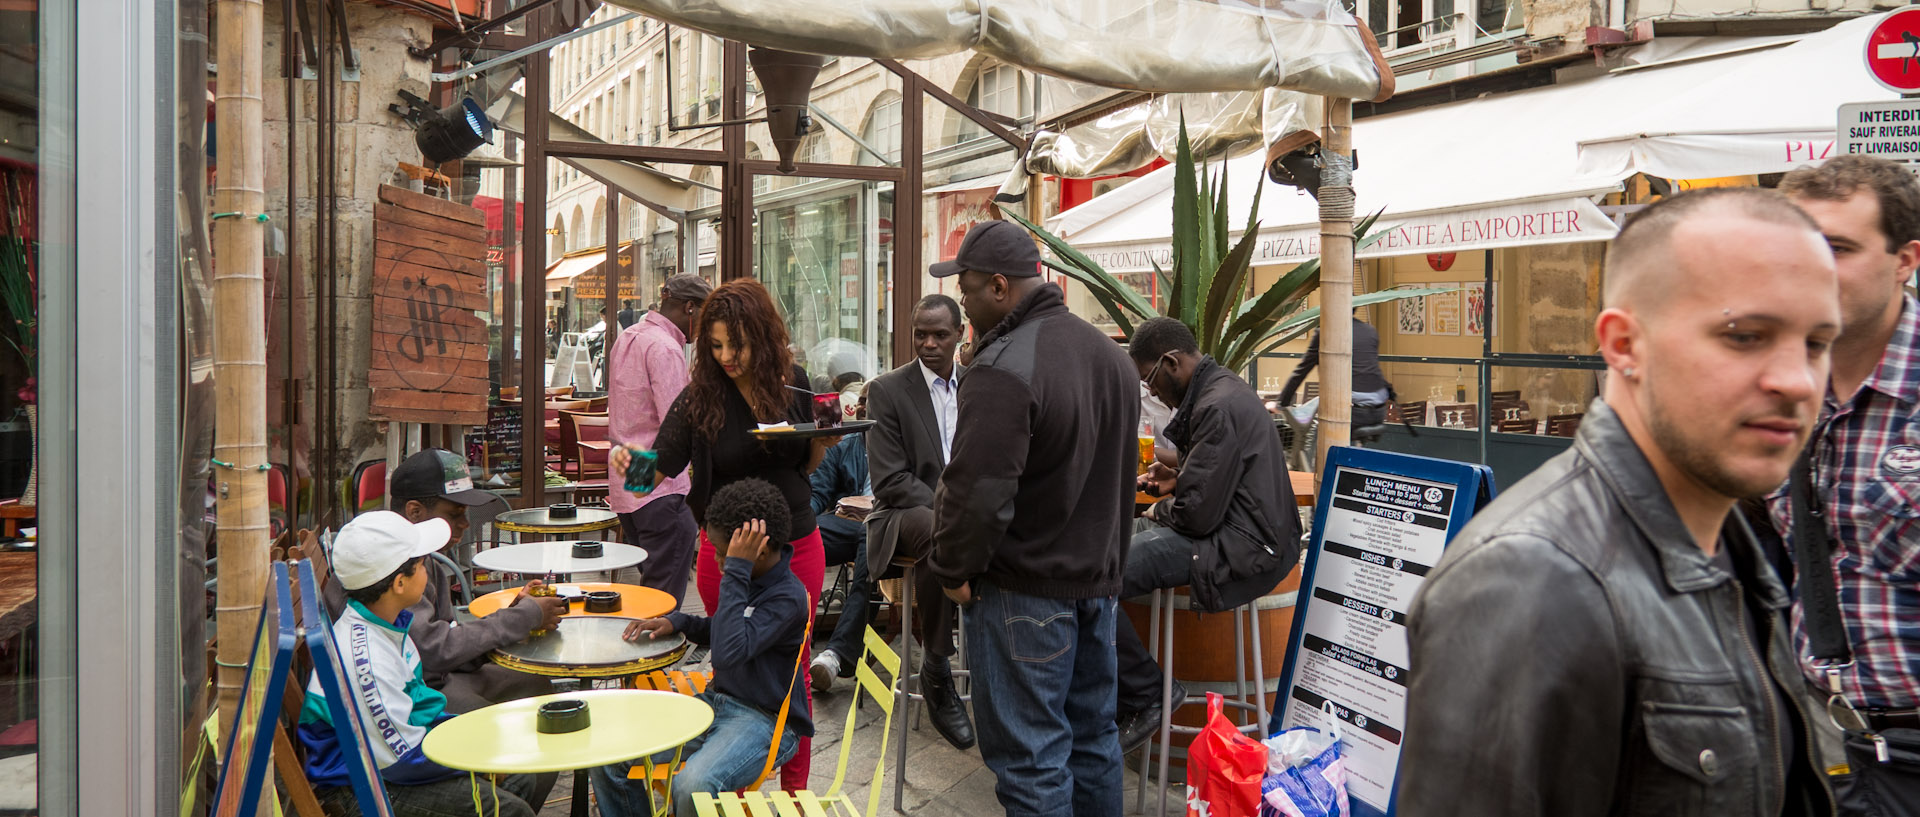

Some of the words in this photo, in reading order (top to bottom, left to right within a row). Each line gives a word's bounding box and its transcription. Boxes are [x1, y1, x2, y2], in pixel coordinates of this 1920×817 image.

[1850, 127, 1876, 138] SAUF
[1785, 139, 1834, 162] PIZ
[1849, 143, 1862, 153] ET
[1866, 142, 1920, 153] LIVRAISO
[1263, 238, 1304, 258] PIZZA
[1441, 224, 1455, 243] A
[1461, 210, 1582, 242] EMPORTER
[577, 288, 636, 296] RESTAANT
[1366, 478, 1393, 489] LUNCH
[1395, 483, 1420, 493] MENU
[1352, 489, 1371, 498] Starter
[1376, 494, 1390, 502] Dish
[1395, 497, 1418, 507] dessert
[1422, 502, 1443, 512] coffee
[1381, 488, 1396, 496] 11am
[1409, 493, 1422, 502] pm)
[1426, 489, 1443, 502] 15€
[1366, 506, 1402, 520] STARTERS
[1361, 552, 1386, 565] DISHES
[1343, 598, 1378, 615] DESSERTS
[1322, 648, 1336, 658] Salad
[1341, 655, 1361, 668] dessert
[1365, 664, 1382, 676] coffee
[1332, 645, 1350, 656] SALADS
[1351, 652, 1377, 667] FORMULAS
[369, 703, 385, 718] IT
[1334, 706, 1349, 719] APAS
[377, 718, 397, 741] DO
[389, 738, 408, 757] ST
